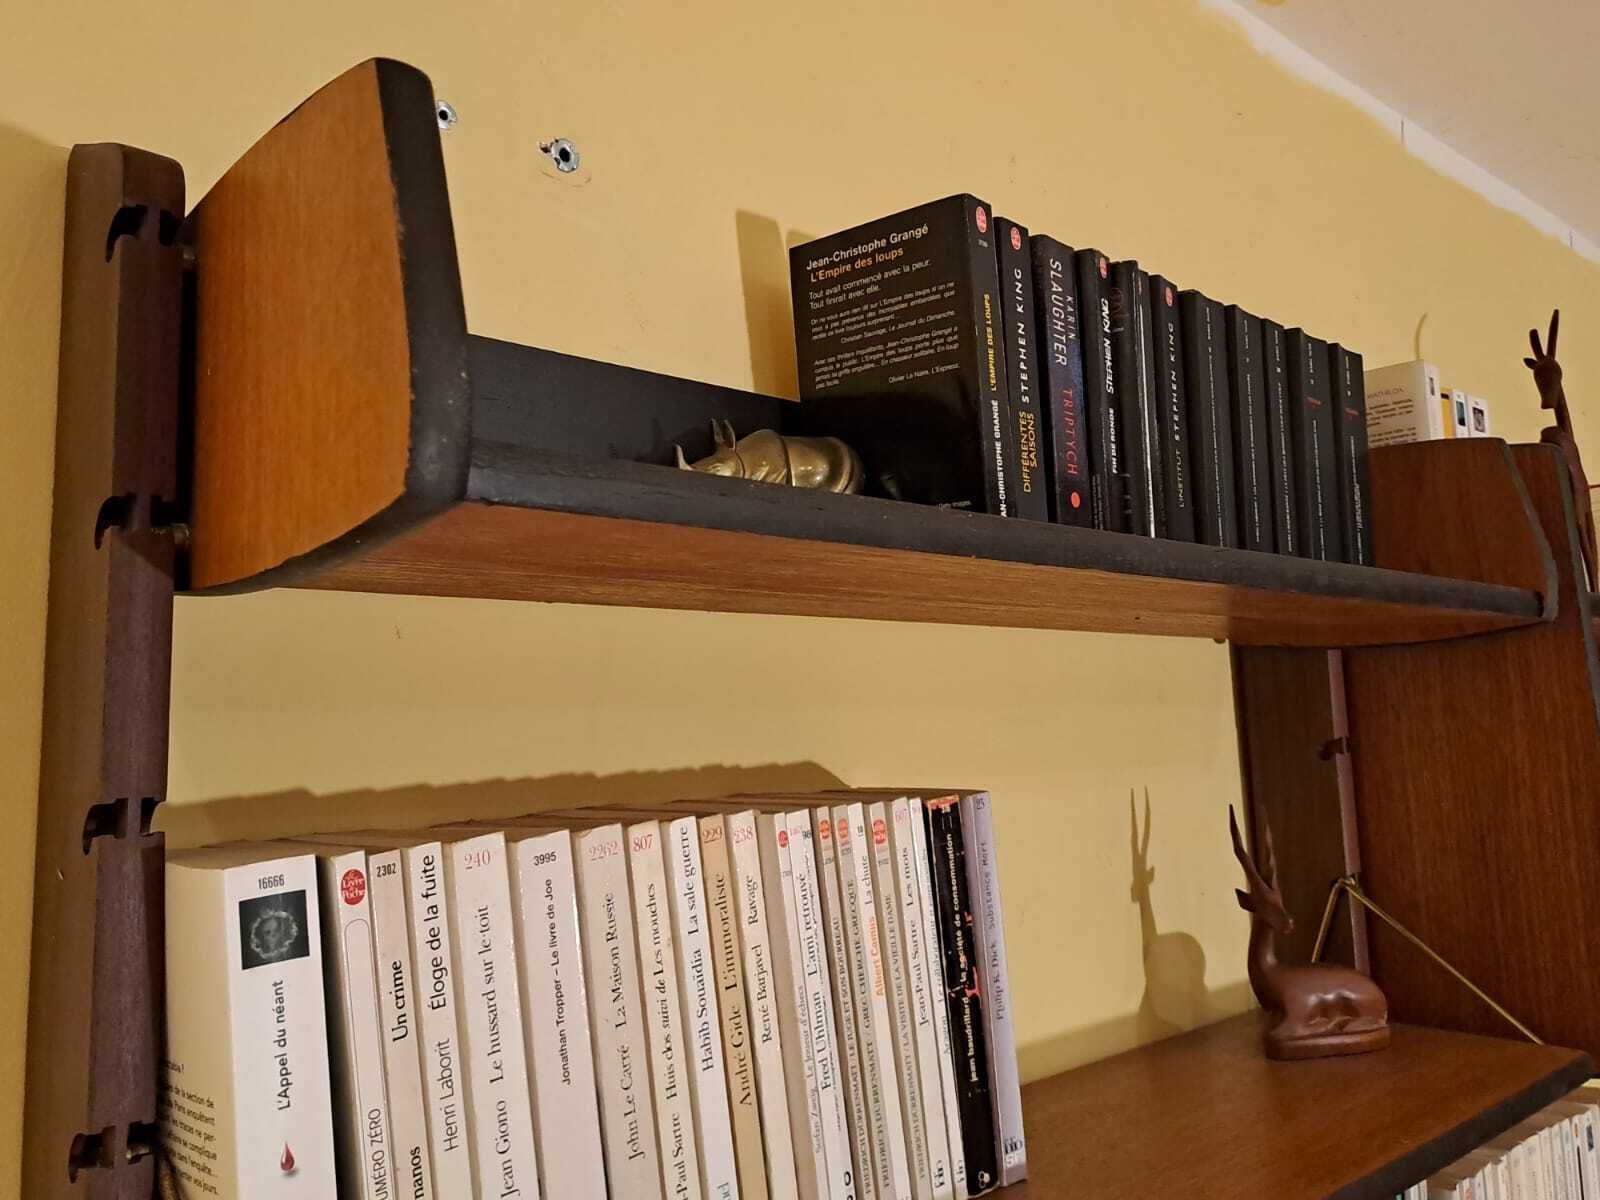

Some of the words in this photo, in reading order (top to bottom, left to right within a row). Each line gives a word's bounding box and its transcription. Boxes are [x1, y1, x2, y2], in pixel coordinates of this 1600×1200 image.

[806, 238, 887, 270] Jean-Christophe
[889, 223, 929, 244] Grangé
[810, 263, 852, 282] L'Empire
[854, 257, 873, 270] des
[875, 247, 904, 264] loups
[808, 290, 824, 300] Tout
[883, 267, 901, 279] avec
[1014, 268, 1024, 313] KING
[983, 293, 992, 325] LOUPS
[1050, 257, 1068, 366] SLAUGHTER
[1066, 295, 1077, 339] KARIN
[1101, 298, 1111, 333] KING
[987, 327, 995, 350] DES
[1167, 322, 1177, 363] KING
[1018, 322, 1030, 404] STEPHEN
[1103, 337, 1114, 394] STEPHEN
[1171, 370, 1180, 442] STEPHEN
[1027, 412, 1038, 467] SAISONS
[1063, 388, 1078, 475] TRIPTYCH
[633, 834, 653, 852] 807
[680, 825, 697, 879] guerre
[702, 826, 723, 844] 229
[734, 827, 754, 844] 238
[376, 863, 397, 878] 2302
[420, 854, 437, 899] fuite
[464, 848, 491, 870] 240
[533, 851, 557, 867] 3995
[861, 856, 871, 887] chute
[903, 847, 911, 879] mots
[946, 833, 960, 911] consommation
[258, 874, 285, 890] 16666
[544, 879, 555, 901] Joe
[684, 882, 697, 912] sale
[746, 876, 759, 925] Ravage
[797, 873, 812, 931] retrouvé
[865, 889, 873, 905] La
[906, 883, 914, 906] Les
[424, 904, 440, 922] la
[474, 904, 491, 934] toit
[547, 904, 555, 920] de
[602, 892, 618, 943] Russie
[646, 883, 661, 945] mouches
[687, 912, 699, 936] La
[847, 879, 859, 936] GRECQUE
[953, 913, 962, 928] de
[426, 926, 441, 951] de
[478, 938, 492, 956] le
[549, 921, 559, 949] livre
[910, 919, 920, 960] Sartre
[482, 959, 495, 985] sur
[551, 950, 560, 967] Le
[608, 945, 625, 1004] Maison
[653, 949, 664, 977] Les
[751, 944, 769, 1001] Barjavel
[854, 940, 865, 995] CHERCHE
[272, 980, 285, 1023] néant
[389, 960, 406, 1010] crime
[428, 955, 448, 1011] Éloge
[553, 978, 565, 1027] Tropper
[655, 979, 666, 995] de
[688, 949, 708, 1018] Souaïdia
[913, 963, 929, 1026] Jean-Paul
[392, 1013, 408, 1042] Un
[481, 988, 503, 1057] hussard
[615, 1005, 627, 1029] La
[729, 1005, 744, 1048] Gide
[758, 1005, 773, 1044] René
[813, 991, 827, 1053] Uhlman
[962, 996, 976, 1057] baudrillard
[273, 1029, 287, 1048] du
[556, 1028, 571, 1086] Jonathan
[698, 1021, 714, 1072] Habib
[274, 1053, 293, 1111] L'Appel
[434, 1038, 455, 1101] Laborit
[489, 1060, 504, 1084] Le
[616, 1044, 633, 1091] Carré
[664, 1065, 678, 1100] Huis
[735, 1053, 752, 1107] André
[818, 1056, 831, 1091] Fred
[623, 1094, 638, 1118] Le
[368, 1108, 384, 1147] ZÉRO
[440, 1103, 459, 1153] Henri
[496, 1100, 511, 1155] Giono
[627, 1119, 645, 1161] John
[672, 1112, 684, 1158] Sartre
[501, 1159, 520, 1198] Jean
[674, 1160, 689, 1200] -Paul
